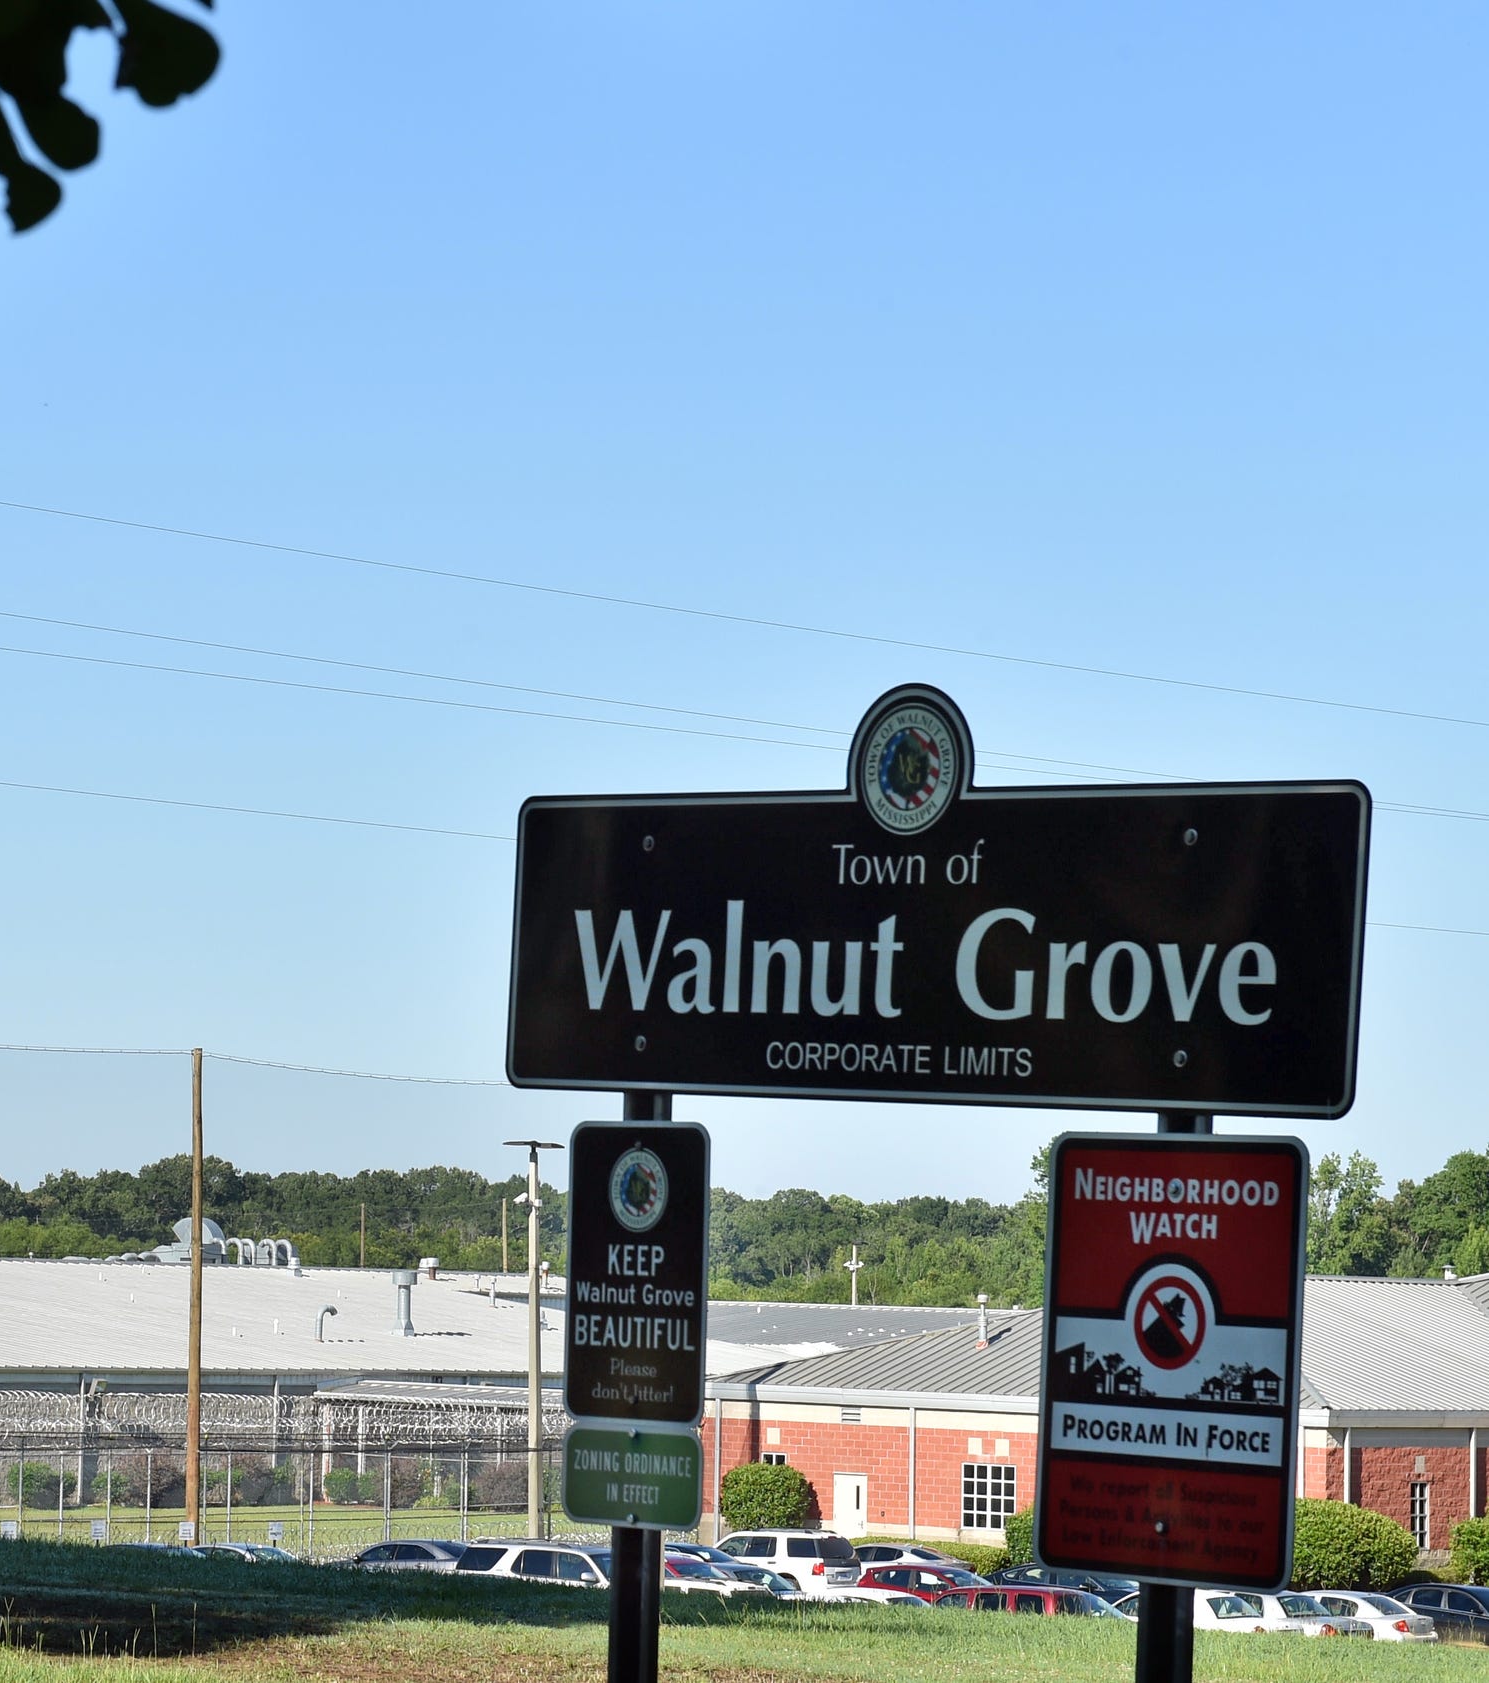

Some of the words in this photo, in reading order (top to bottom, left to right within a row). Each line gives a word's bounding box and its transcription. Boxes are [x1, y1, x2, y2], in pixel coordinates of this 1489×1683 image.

[868, 742, 882, 784] TOWN
[881, 724, 894, 740] OF
[896, 713, 942, 737] WALNUT
[938, 738, 951, 787] GROVE
[875, 798, 938, 825] MISSISSIPPI
[832, 844, 926, 885] Town
[946, 838, 985, 885] of
[574, 899, 904, 1018] Walnut
[955, 907, 1277, 1026] Grove
[766, 1041, 931, 1074] CORPORATE
[944, 1045, 1033, 1077] LIMITS
[1074, 1167, 1280, 1206] NEIGHBORHOOD
[1130, 1211, 1218, 1245] WATCH
[608, 1244, 665, 1276] KEEP
[576, 1281, 636, 1304] Walnut
[642, 1284, 695, 1306] Grove
[574, 1314, 696, 1351] BEAUTIFUL
[610, 1357, 657, 1378] Please
[591, 1381, 627, 1400] don't
[1062, 1414, 1167, 1445] PROGRAM
[1207, 1424, 1270, 1453] FORCE
[573, 1449, 620, 1472] ZONING
[624, 1453, 692, 1478] ORDINANCE
[606, 1482, 619, 1502] IN
[623, 1484, 660, 1504] EFFECT
[1099, 1481, 1150, 1502] report
